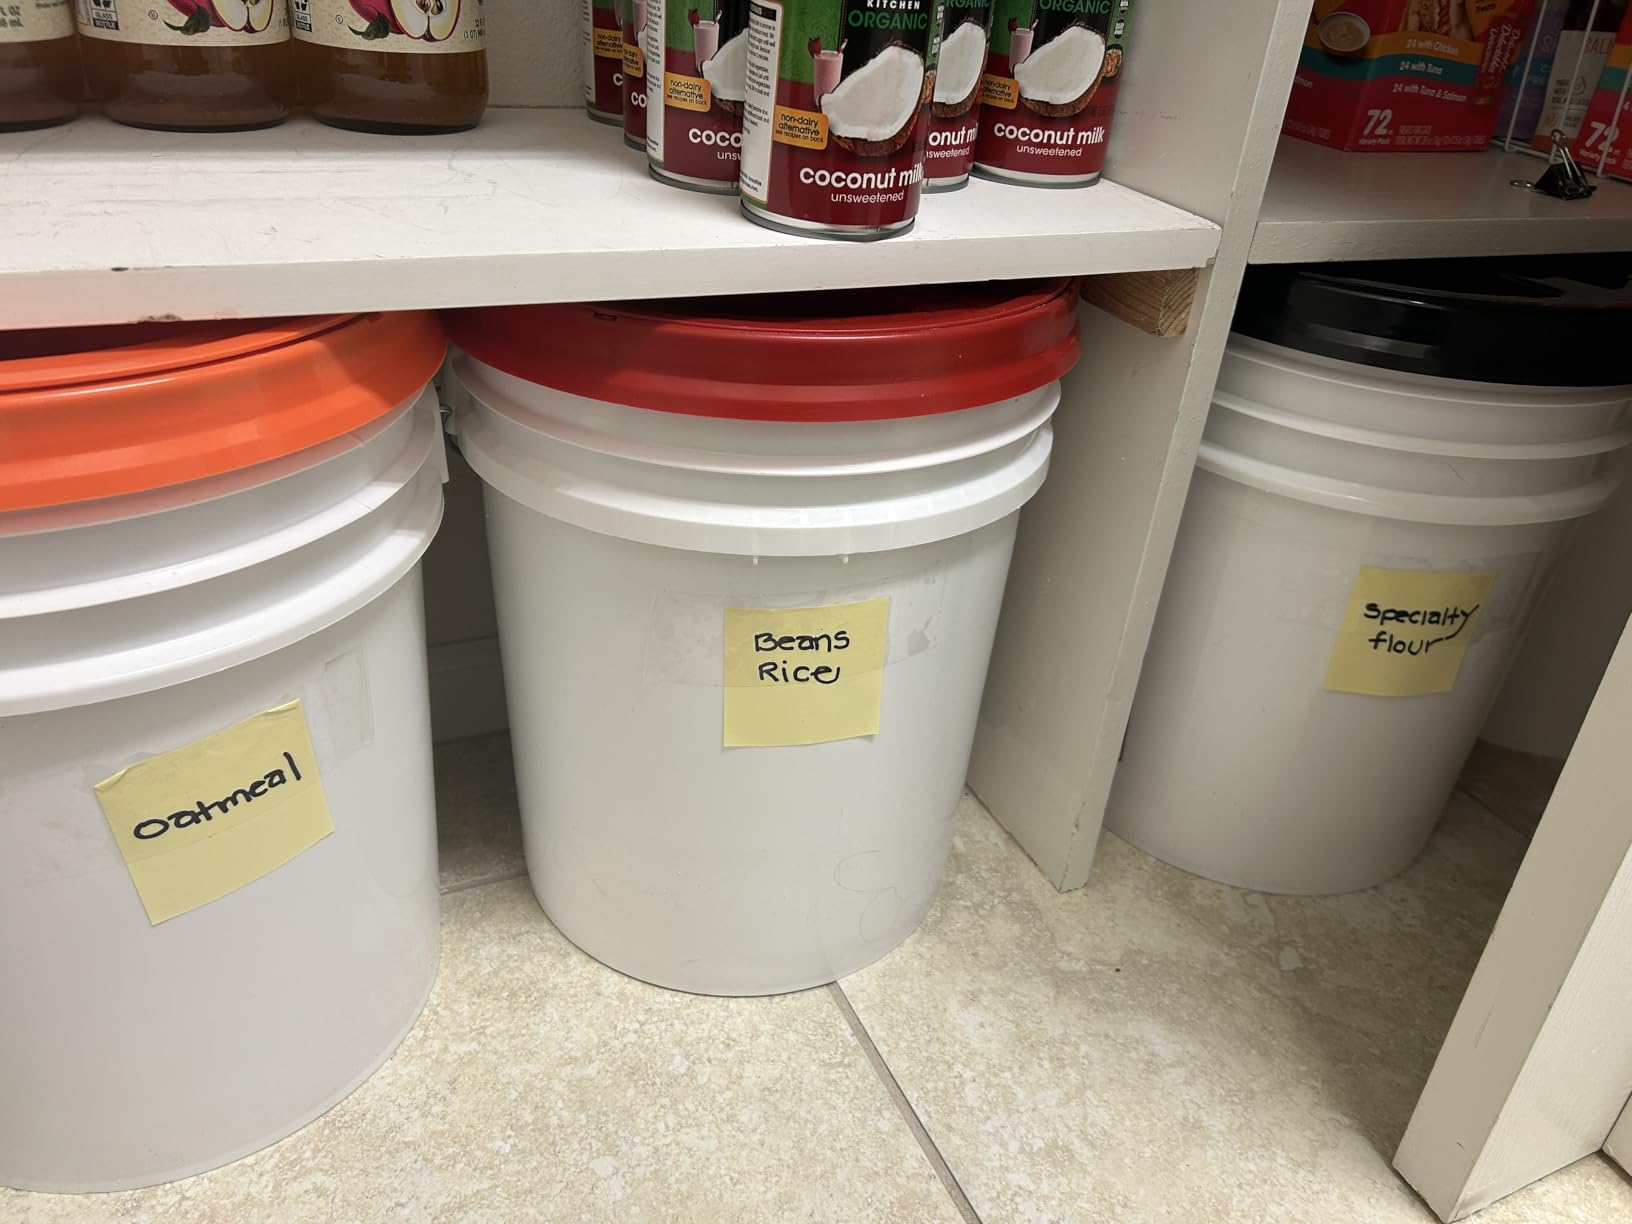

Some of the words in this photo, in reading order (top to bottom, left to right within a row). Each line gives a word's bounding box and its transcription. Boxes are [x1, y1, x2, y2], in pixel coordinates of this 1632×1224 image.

[867, 0, 921, 10] KITCHEN
[847, 10, 928, 30] ORGANIC
[670, 79, 702, 92] non-dairy
[668, 87, 705, 101] alternative
[781, 112, 819, 128] non-dairy
[1363, 108, 1392, 136] 72
[778, 121, 820, 137] alternative
[994, 122, 1075, 146] coconut
[1077, 126, 1105, 145] milk
[688, 128, 743, 148] coco
[810, 134, 823, 143] back
[1016, 145, 1083, 158] unsweetened
[799, 167, 896, 189] coconut
[831, 190, 905, 204] unsweetened
[754, 630, 851, 653] Beans
[758, 660, 841, 685] Rice
